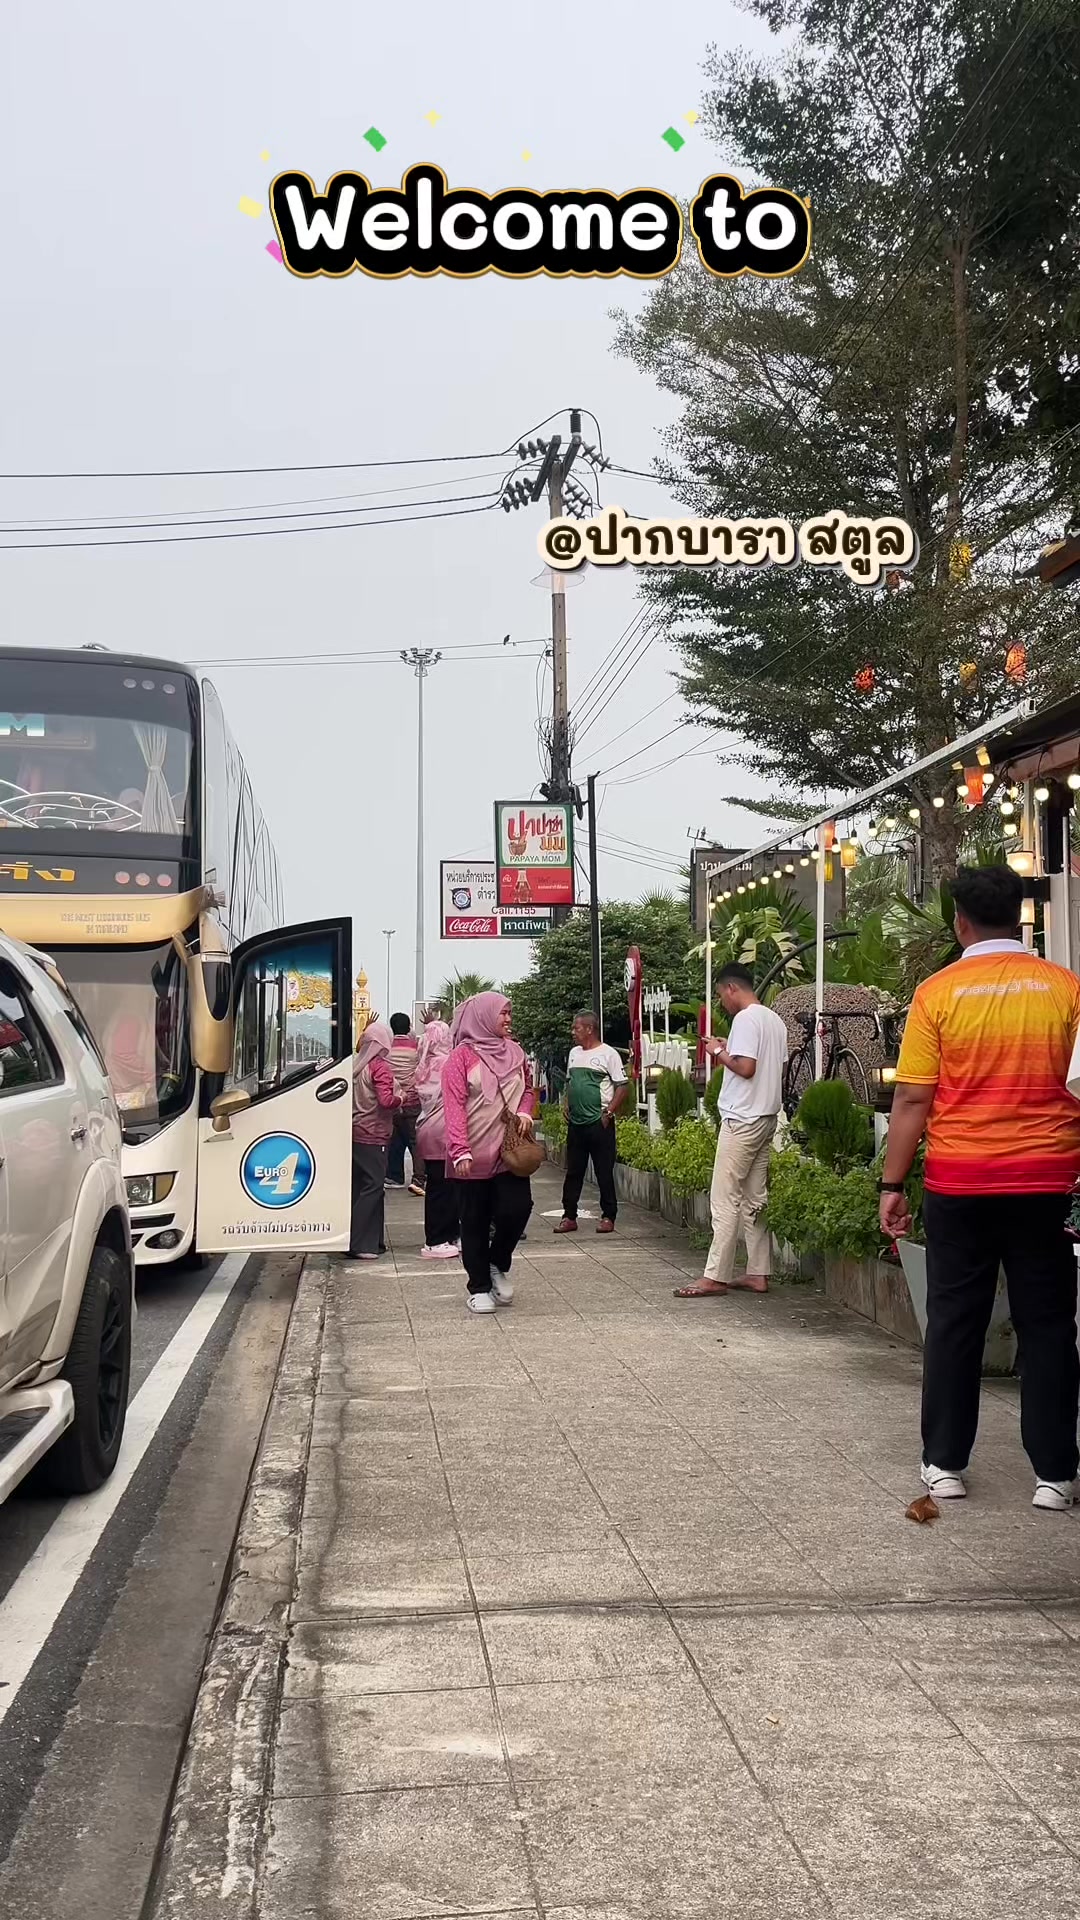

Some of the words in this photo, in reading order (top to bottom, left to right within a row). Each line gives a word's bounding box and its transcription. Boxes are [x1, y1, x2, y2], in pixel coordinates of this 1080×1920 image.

[509, 855, 540, 863] PAPAYA
[541, 855, 561, 863] MOM
[449, 918, 494, 933] Coca-Cola
[259, 1152, 300, 1195] 4
